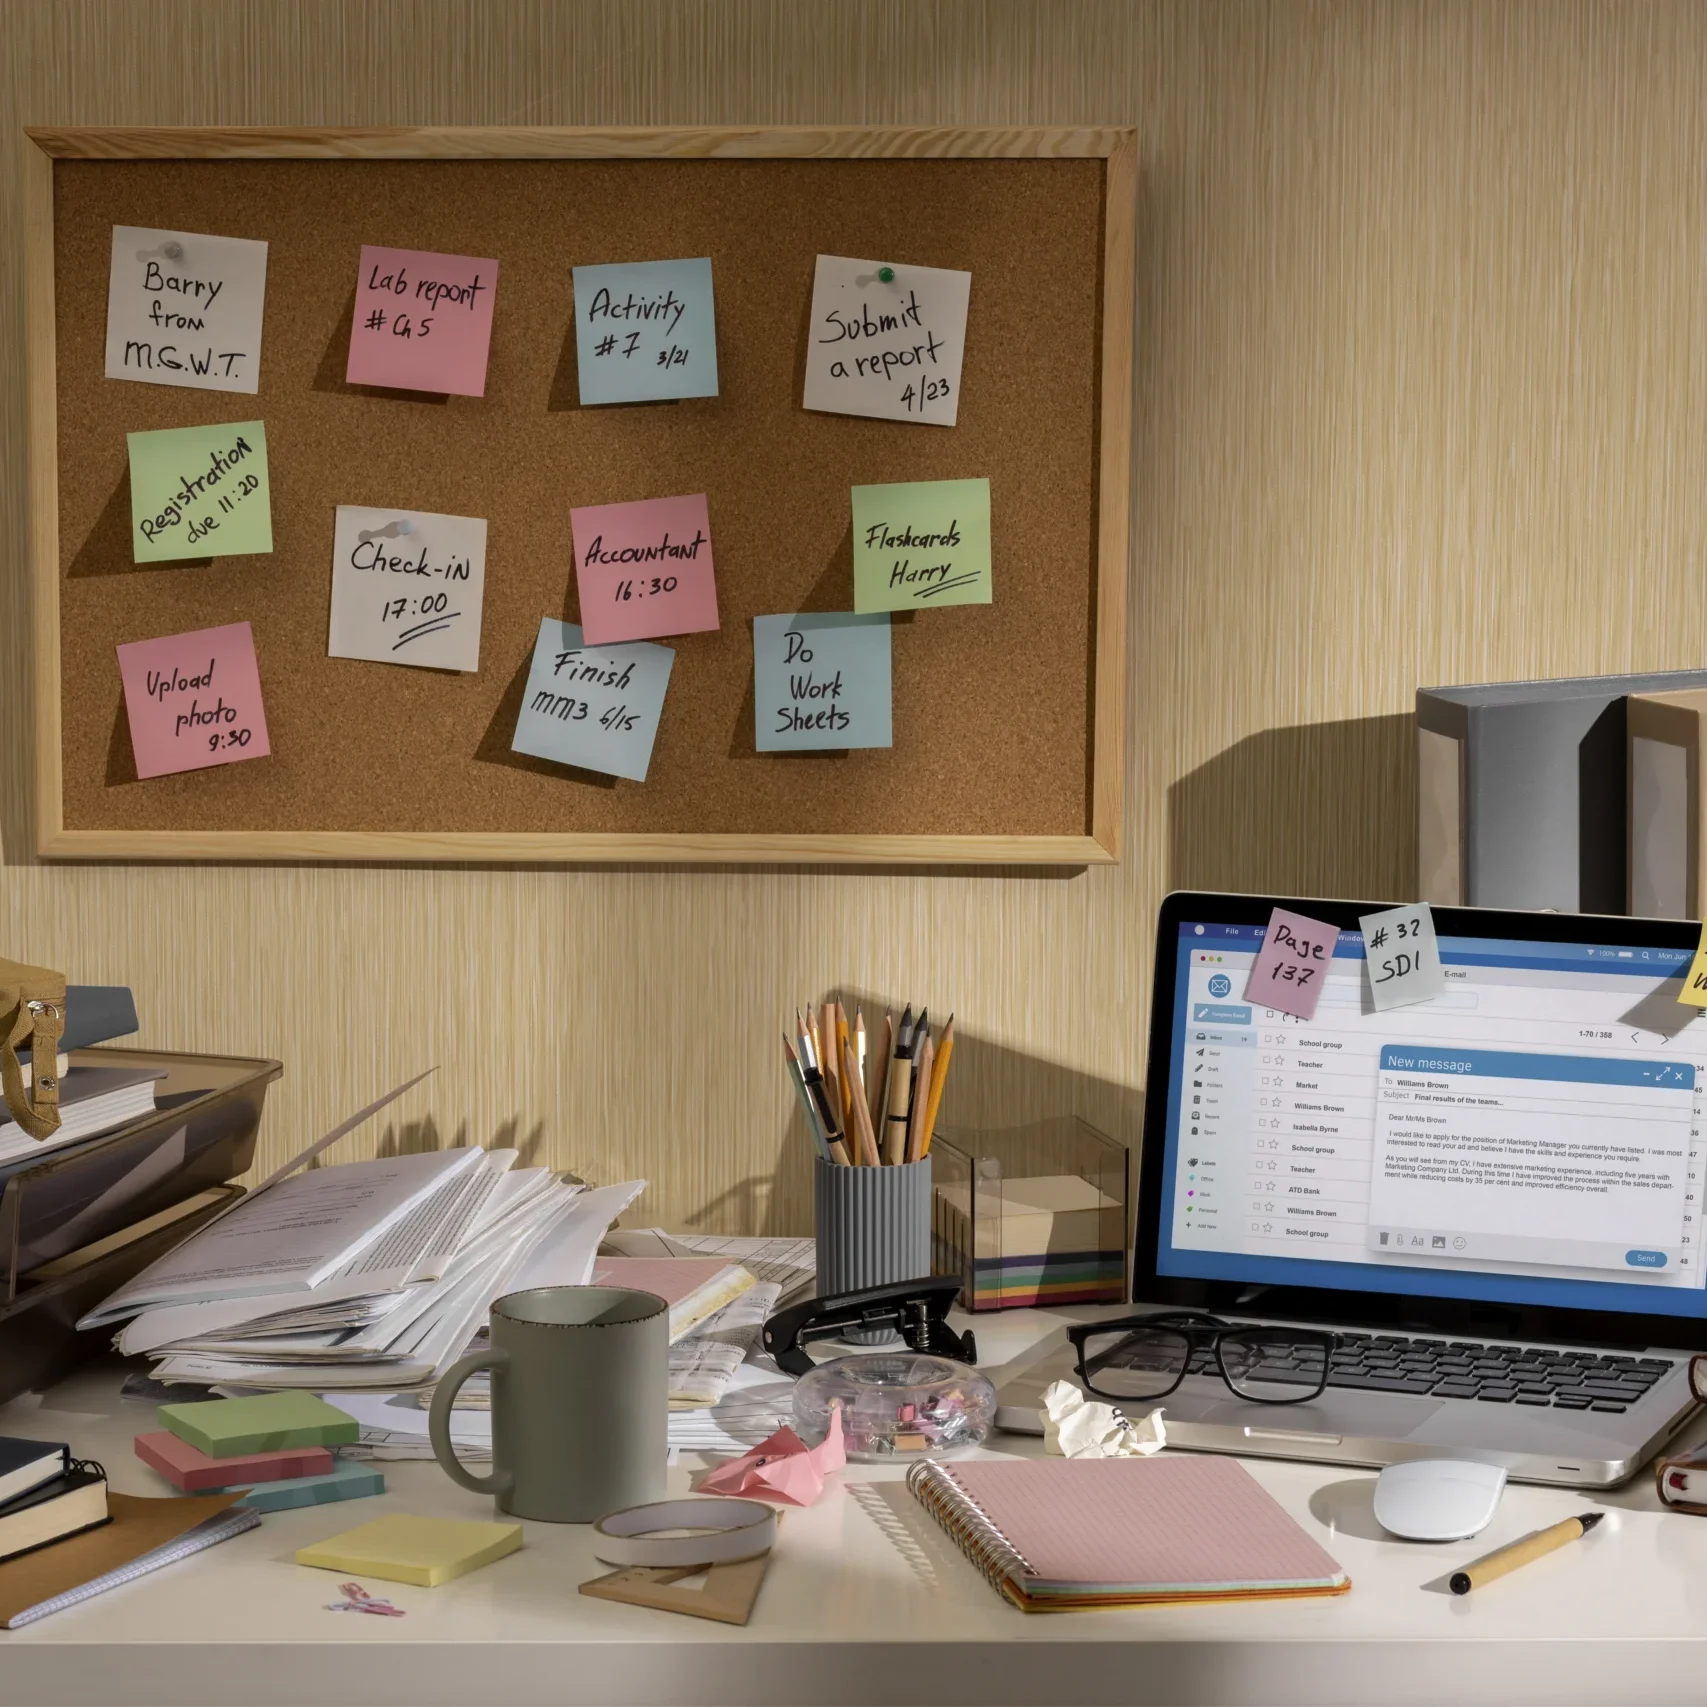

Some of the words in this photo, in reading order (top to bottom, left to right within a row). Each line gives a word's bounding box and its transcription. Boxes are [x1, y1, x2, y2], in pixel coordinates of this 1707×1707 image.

[143, 261, 223, 312] Barry
[368, 264, 408, 295] Lab
[415, 274, 486, 312] report
[148, 299, 205, 331] from
[588, 287, 686, 338] Activity
[818, 290, 922, 344] Submit
[124, 340, 247, 378] M.G.W.T.
[656, 344, 688, 370] 3/21
[830, 361, 848, 378] a
[855, 330, 946, 382] report
[900, 374, 950, 413] 4/23
[187, 516, 221, 544] due
[218, 474, 259, 514] 11:20
[864, 519, 961, 550] Flashcards
[889, 560, 952, 589] Harry
[615, 576, 678, 602] 16:30
[382, 592, 448, 622] 17:00
[783, 631, 814, 664] Do
[146, 658, 215, 704] Upload
[554, 650, 637, 690] Finish
[790, 670, 843, 701] Work
[175, 697, 238, 738] photo
[599, 704, 641, 731] 6/15
[775, 703, 850, 733] Sheets
[208, 728, 252, 752] 9:30
[1225, 927, 1239, 935] File
[1273, 924, 1325, 961] Page
[1271, 961, 1315, 987] 137
[1298, 1039, 1321, 1047] School
[1579, 1030, 1594, 1038] 1-70
[1600, 1031, 1612, 1039] 358
[1298, 1060, 1322, 1068] Teacher
[1388, 1055, 1413, 1067] New
[1417, 1058, 1471, 1073] message
[1295, 1081, 1317, 1089] Market
[1383, 1090, 1409, 1100] Subject
[1432, 1094, 1455, 1102] results
[1396, 1079, 1424, 1087] Williams
[1427, 1081, 1448, 1089] Brown
[1294, 1102, 1321, 1110] Williams
[1323, 1104, 1344, 1112] Brown
[1405, 1114, 1424, 1122] Mr/Ms
[1426, 1116, 1446, 1124] Brown
[1292, 1123, 1317, 1131] Isabella
[1319, 1125, 1338, 1134] Byrne
[1291, 1144, 1314, 1152] School
[1315, 1146, 1334, 1154] group
[1386, 1138, 1417, 1146] interested
[1480, 1144, 1502, 1152] believe
[1508, 1146, 1523, 1154] have
[1536, 1148, 1552, 1156] skills
[1567, 1151, 1602, 1160] experience
[1616, 1154, 1640, 1163] require.
[1432, 1133, 1449, 1141] apply
[1472, 1136, 1497, 1145] position
[1506, 1138, 1537, 1148] Marketing
[1538, 1140, 1566, 1150] Manager
[1581, 1143, 1608, 1153] currently
[1627, 1146, 1645, 1154] listed.
[1384, 1162, 1415, 1172] Marketing
[1417, 1164, 1447, 1174] Company
[1461, 1168, 1482, 1177] During
[1515, 1171, 1531, 1179] have
[1532, 1173, 1561, 1182] improved
[1574, 1177, 1600, 1185] process
[1651, 1181, 1674, 1190] depart-
[1493, 1162, 1522, 1170] extensive
[1524, 1164, 1555, 1173] marketing
[1556, 1166, 1593, 1176] experience,
[1594, 1169, 1623, 1178] including
[1637, 1173, 1655, 1181] years
[1287, 1207, 1314, 1215] Williams
[1285, 1228, 1308, 1236] School
[1309, 1230, 1328, 1238] group
[1637, 1254, 1655, 1263] Send
